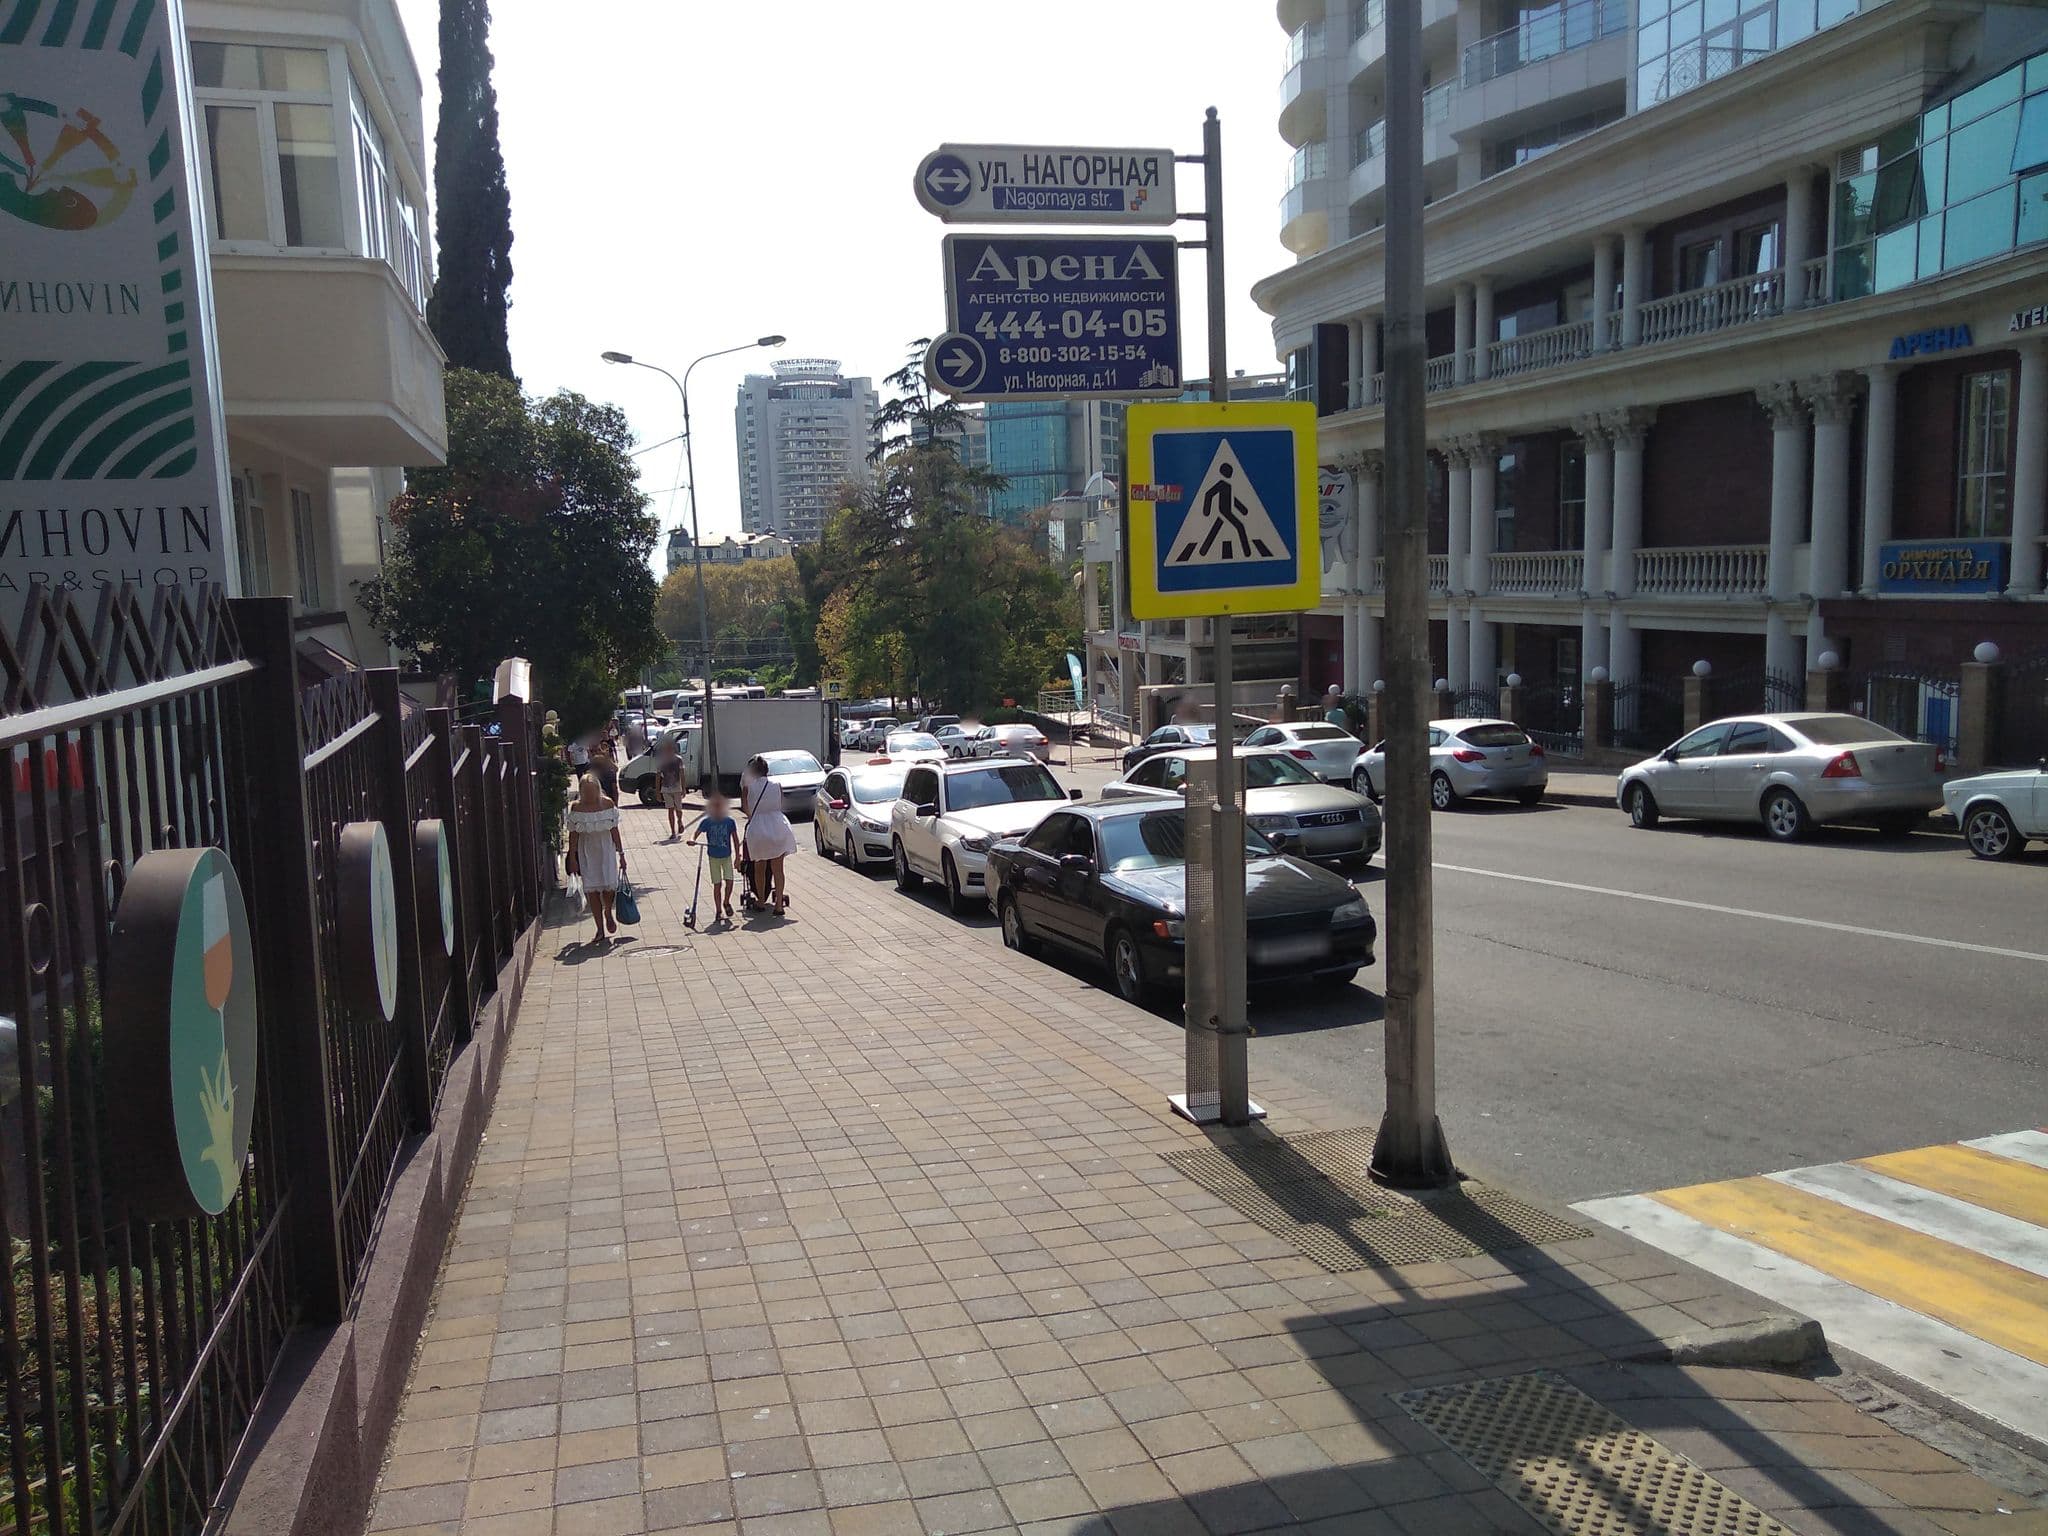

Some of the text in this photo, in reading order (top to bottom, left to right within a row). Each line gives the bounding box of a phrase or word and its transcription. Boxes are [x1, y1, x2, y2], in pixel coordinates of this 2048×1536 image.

[978, 154, 1160, 192] ул. НАГОРНАЯ
[1005, 187, 1113, 209] Nagornaya str.
[966, 244, 1164, 290] АренА
[969, 291, 1165, 304] АГЕНТСТВО НЕДВИЖИМОСТИ
[975, 309, 1167, 340] 444-04-05
[999, 345, 1147, 363] 8-800-302-15-54
[1888, 322, 1974, 360] АРЕНА
[1004, 368, 1117, 394] ул. Нагорная, д.11
[1884, 560, 1990, 583] ОРХИДЕЯ
